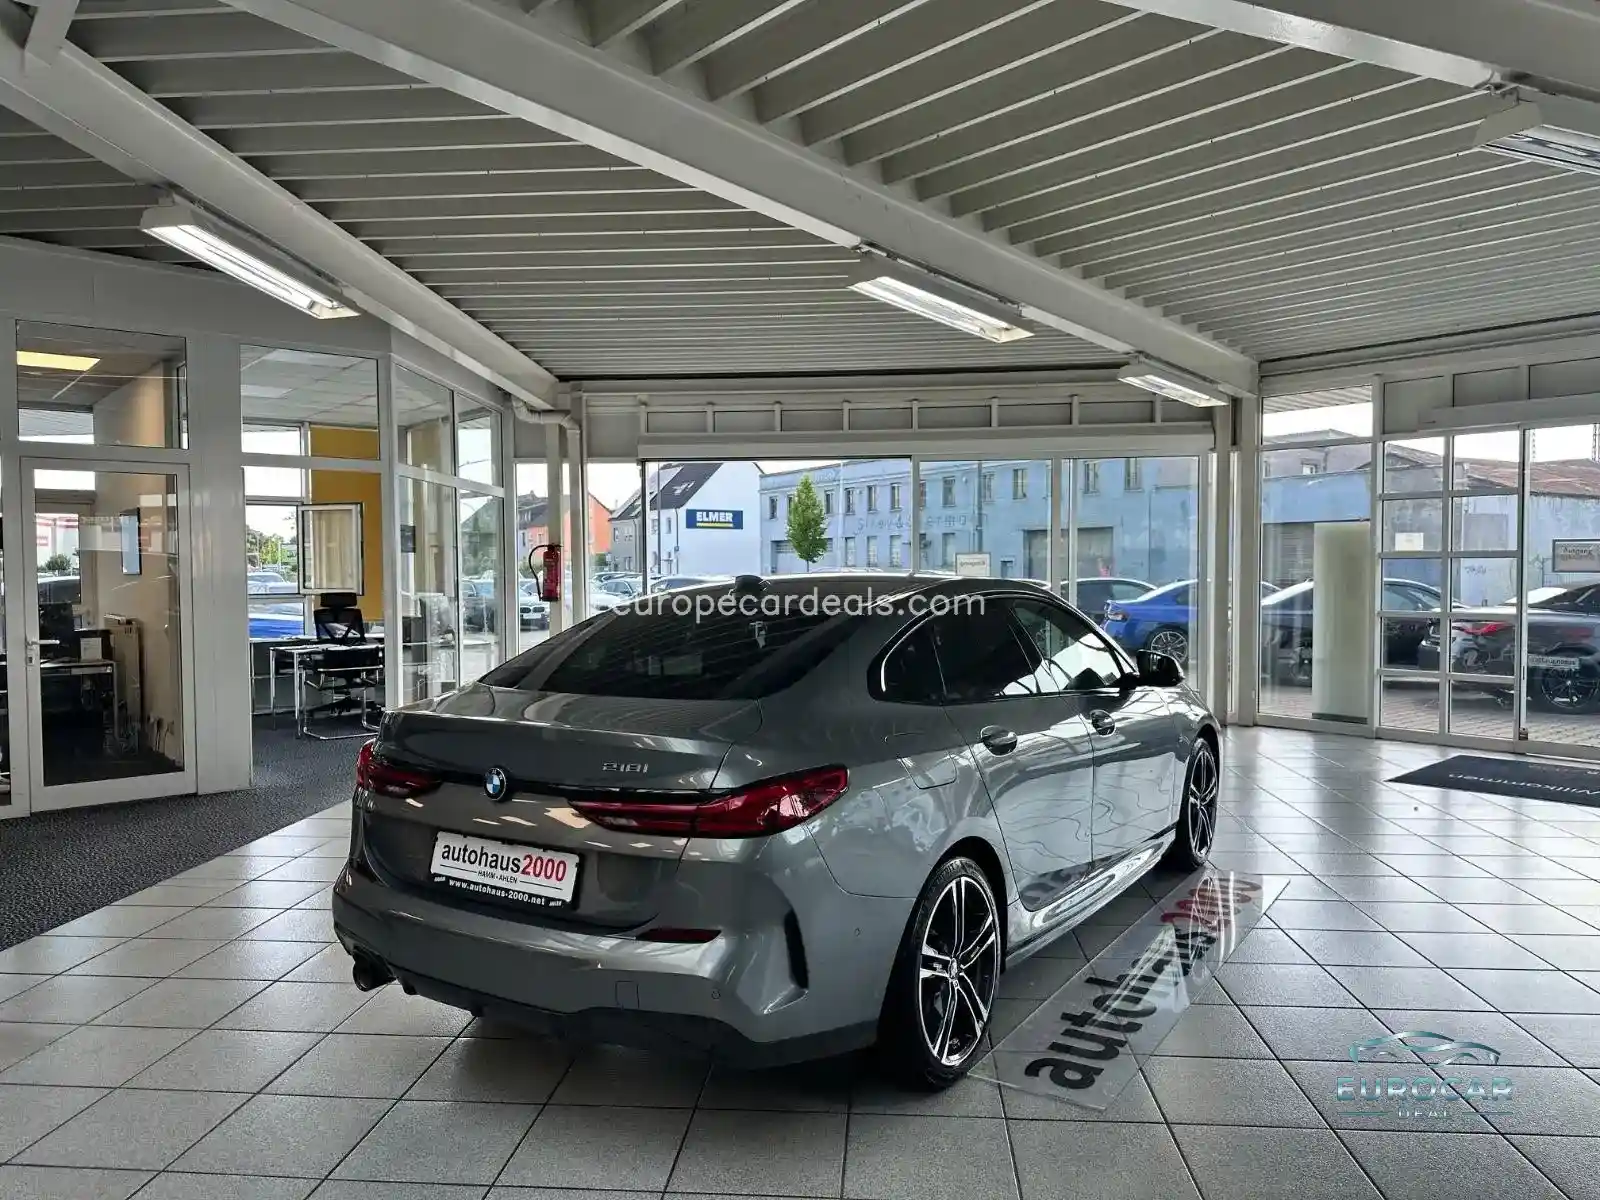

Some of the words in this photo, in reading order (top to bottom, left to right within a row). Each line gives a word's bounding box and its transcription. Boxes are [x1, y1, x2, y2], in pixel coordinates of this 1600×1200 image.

[696, 511, 733, 522] ELMER
[441, 844, 567, 882] autohaus2000
[449, 879, 545, 906] www.autohaus-2000.net
